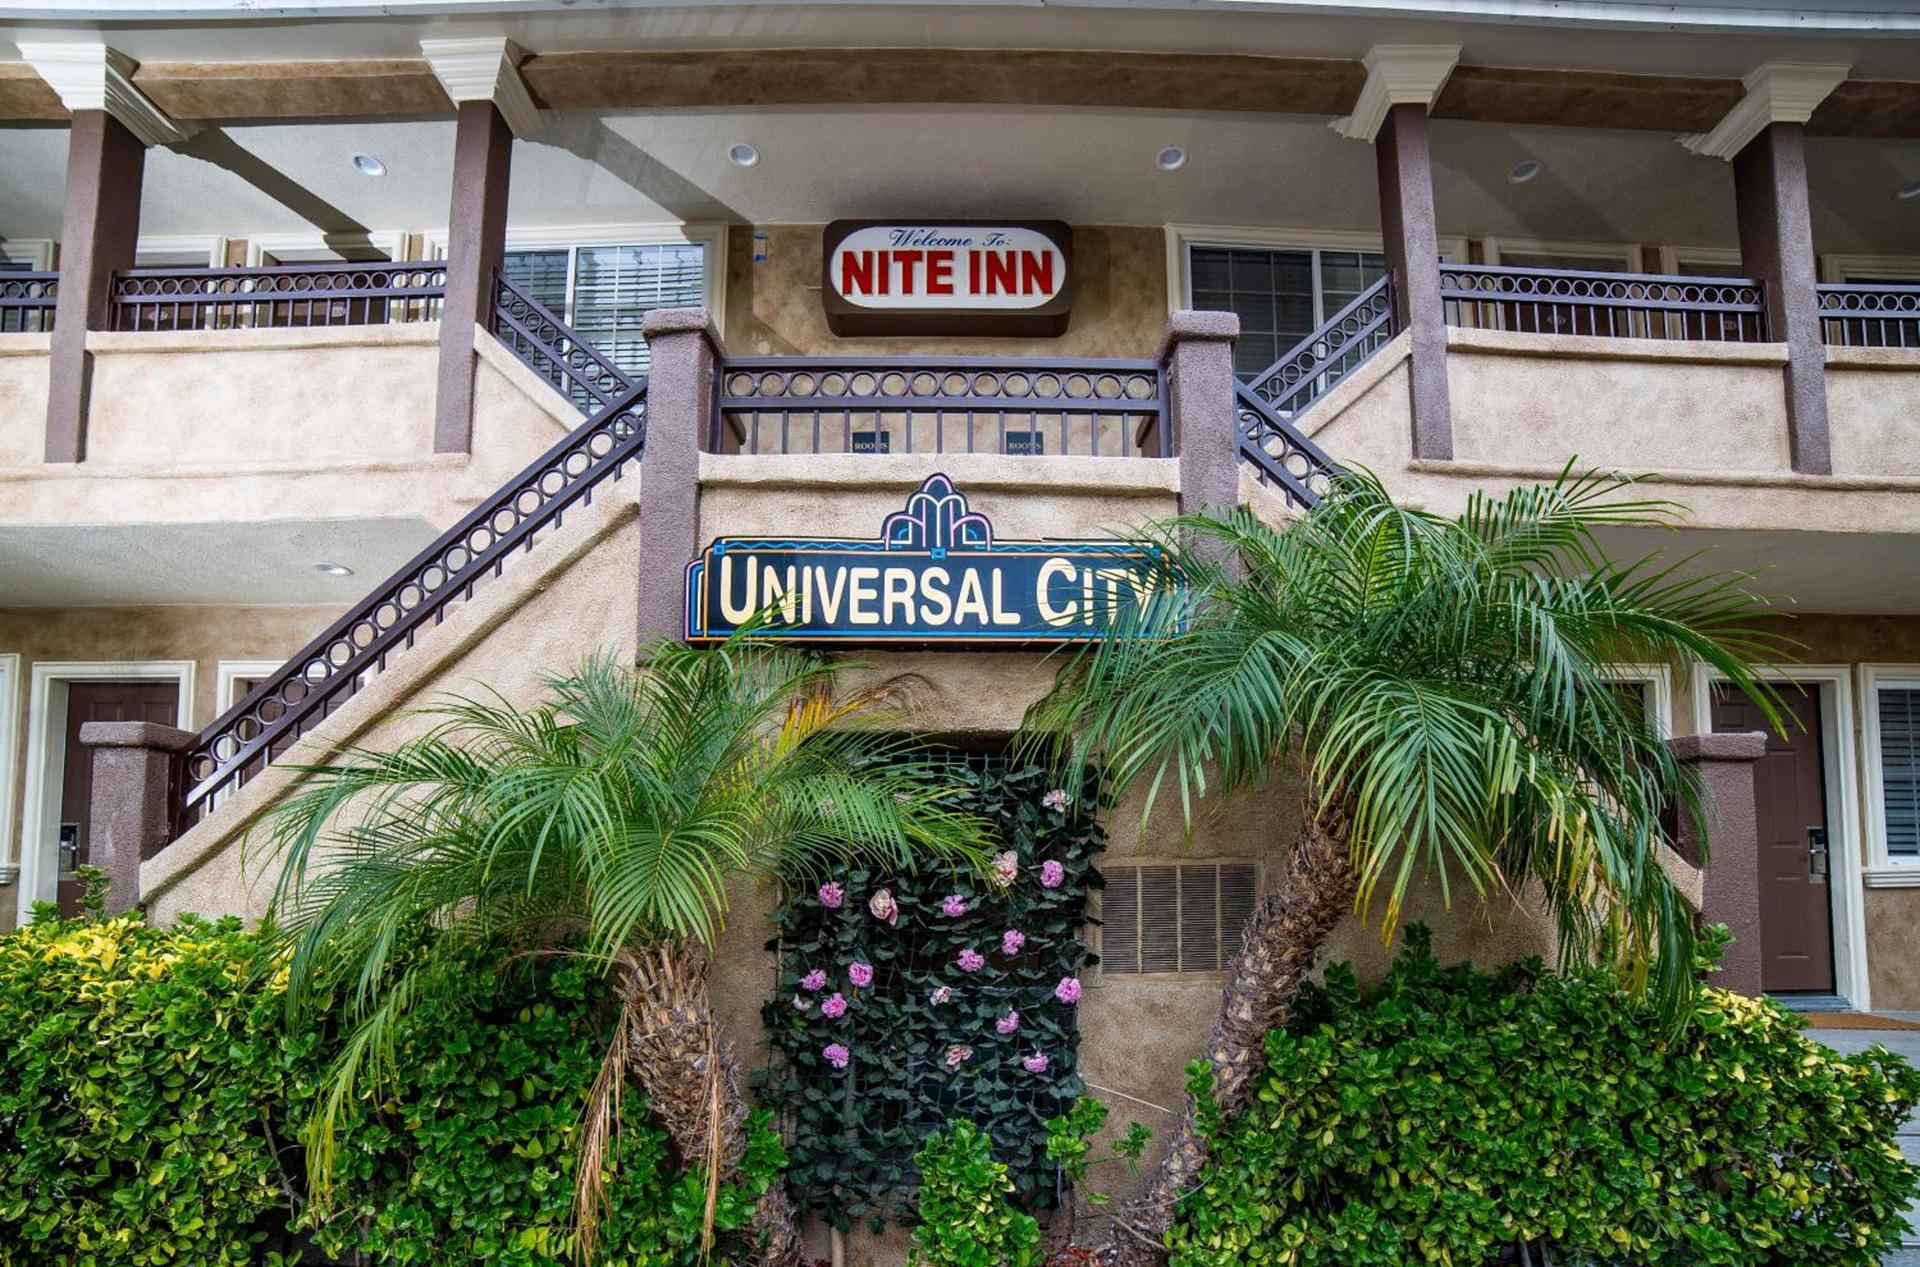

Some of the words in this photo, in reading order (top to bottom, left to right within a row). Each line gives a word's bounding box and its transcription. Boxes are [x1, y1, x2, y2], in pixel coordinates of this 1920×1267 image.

[889, 229, 973, 247] Welcome
[842, 250, 954, 295] NITE
[969, 250, 1053, 295] INN
[854, 442, 888, 450] ROOS
[720, 555, 1021, 625] UNIVERSAL
[1036, 557, 1159, 627] CITY
